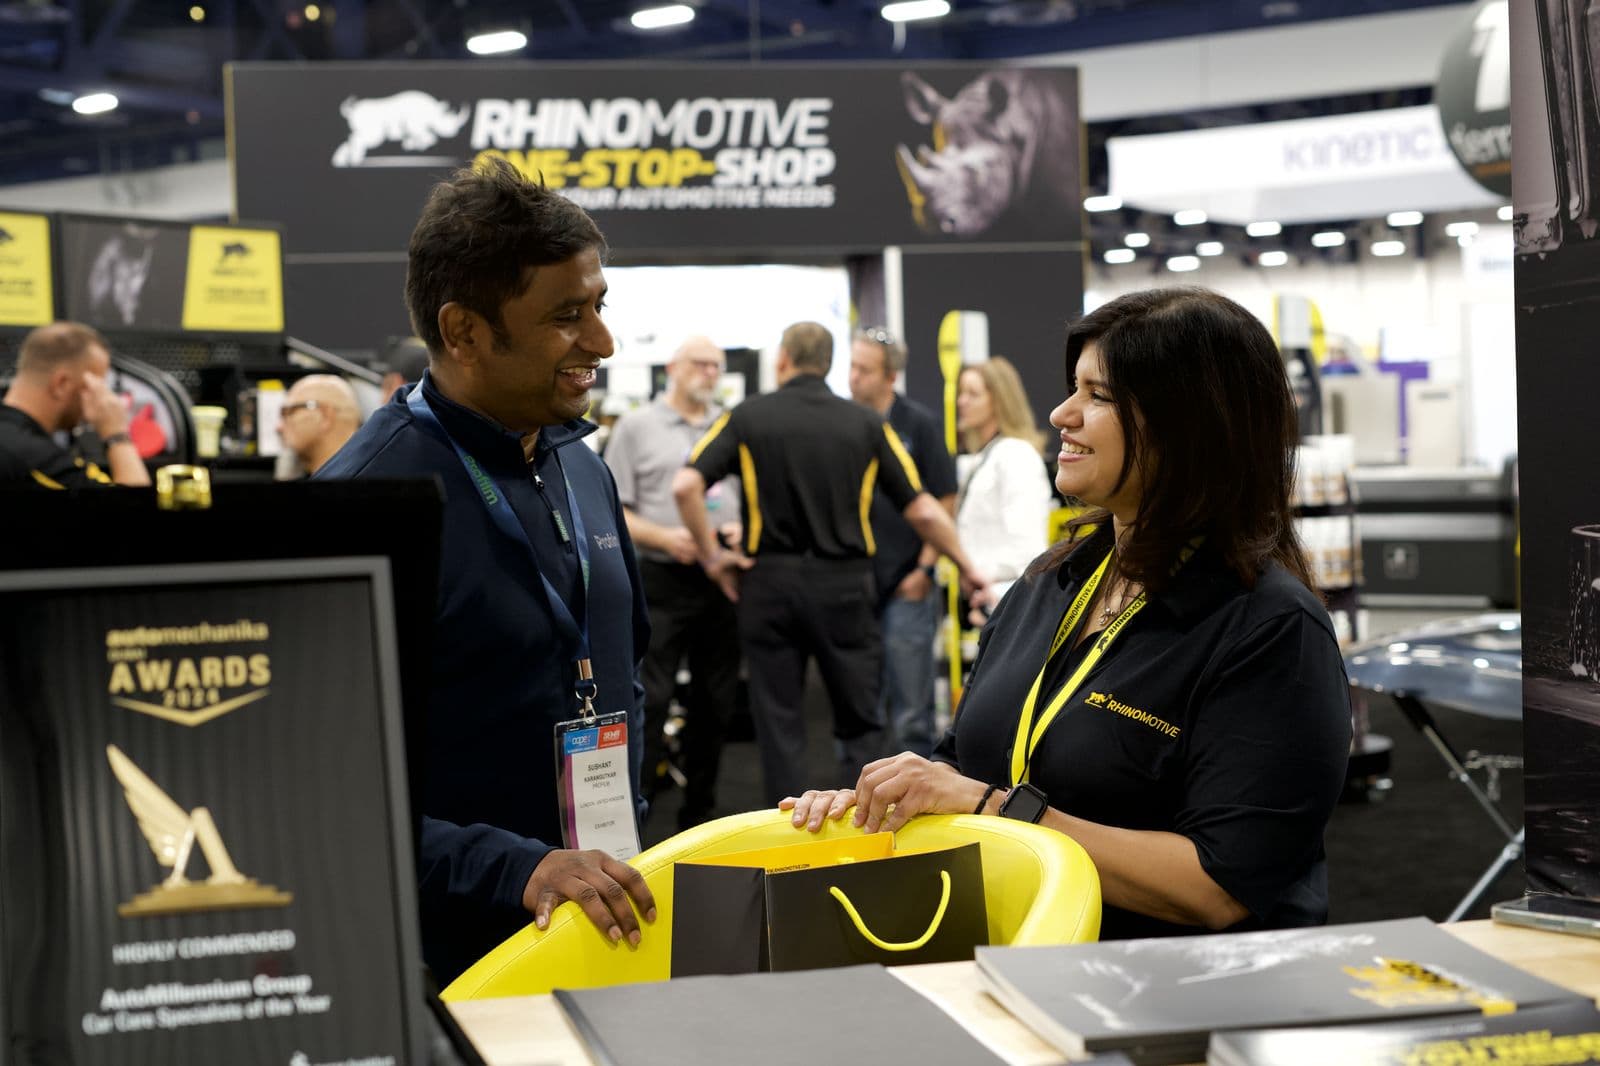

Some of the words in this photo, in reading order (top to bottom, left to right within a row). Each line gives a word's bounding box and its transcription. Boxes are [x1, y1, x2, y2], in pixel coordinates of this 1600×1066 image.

[471, 98, 833, 149] RHINOMOTIVE
[618, 186, 761, 209] AUTOMOTIVE
[763, 185, 836, 208] NEEDS
[106, 619, 268, 647] automechanika
[108, 654, 271, 693] AWARDS
[1106, 699, 1181, 738] RHINOMOTIVE
[112, 941, 177, 965] HIGHLY
[178, 929, 296, 959] COMMENDED
[101, 979, 252, 1011] AutoMillennium
[253, 974, 313, 997] Group
[82, 1012, 114, 1035] Car
[115, 1010, 155, 1031] Care
[244, 1000, 264, 1019] of
[264, 997, 294, 1017] the
[294, 994, 332, 1014] Year
